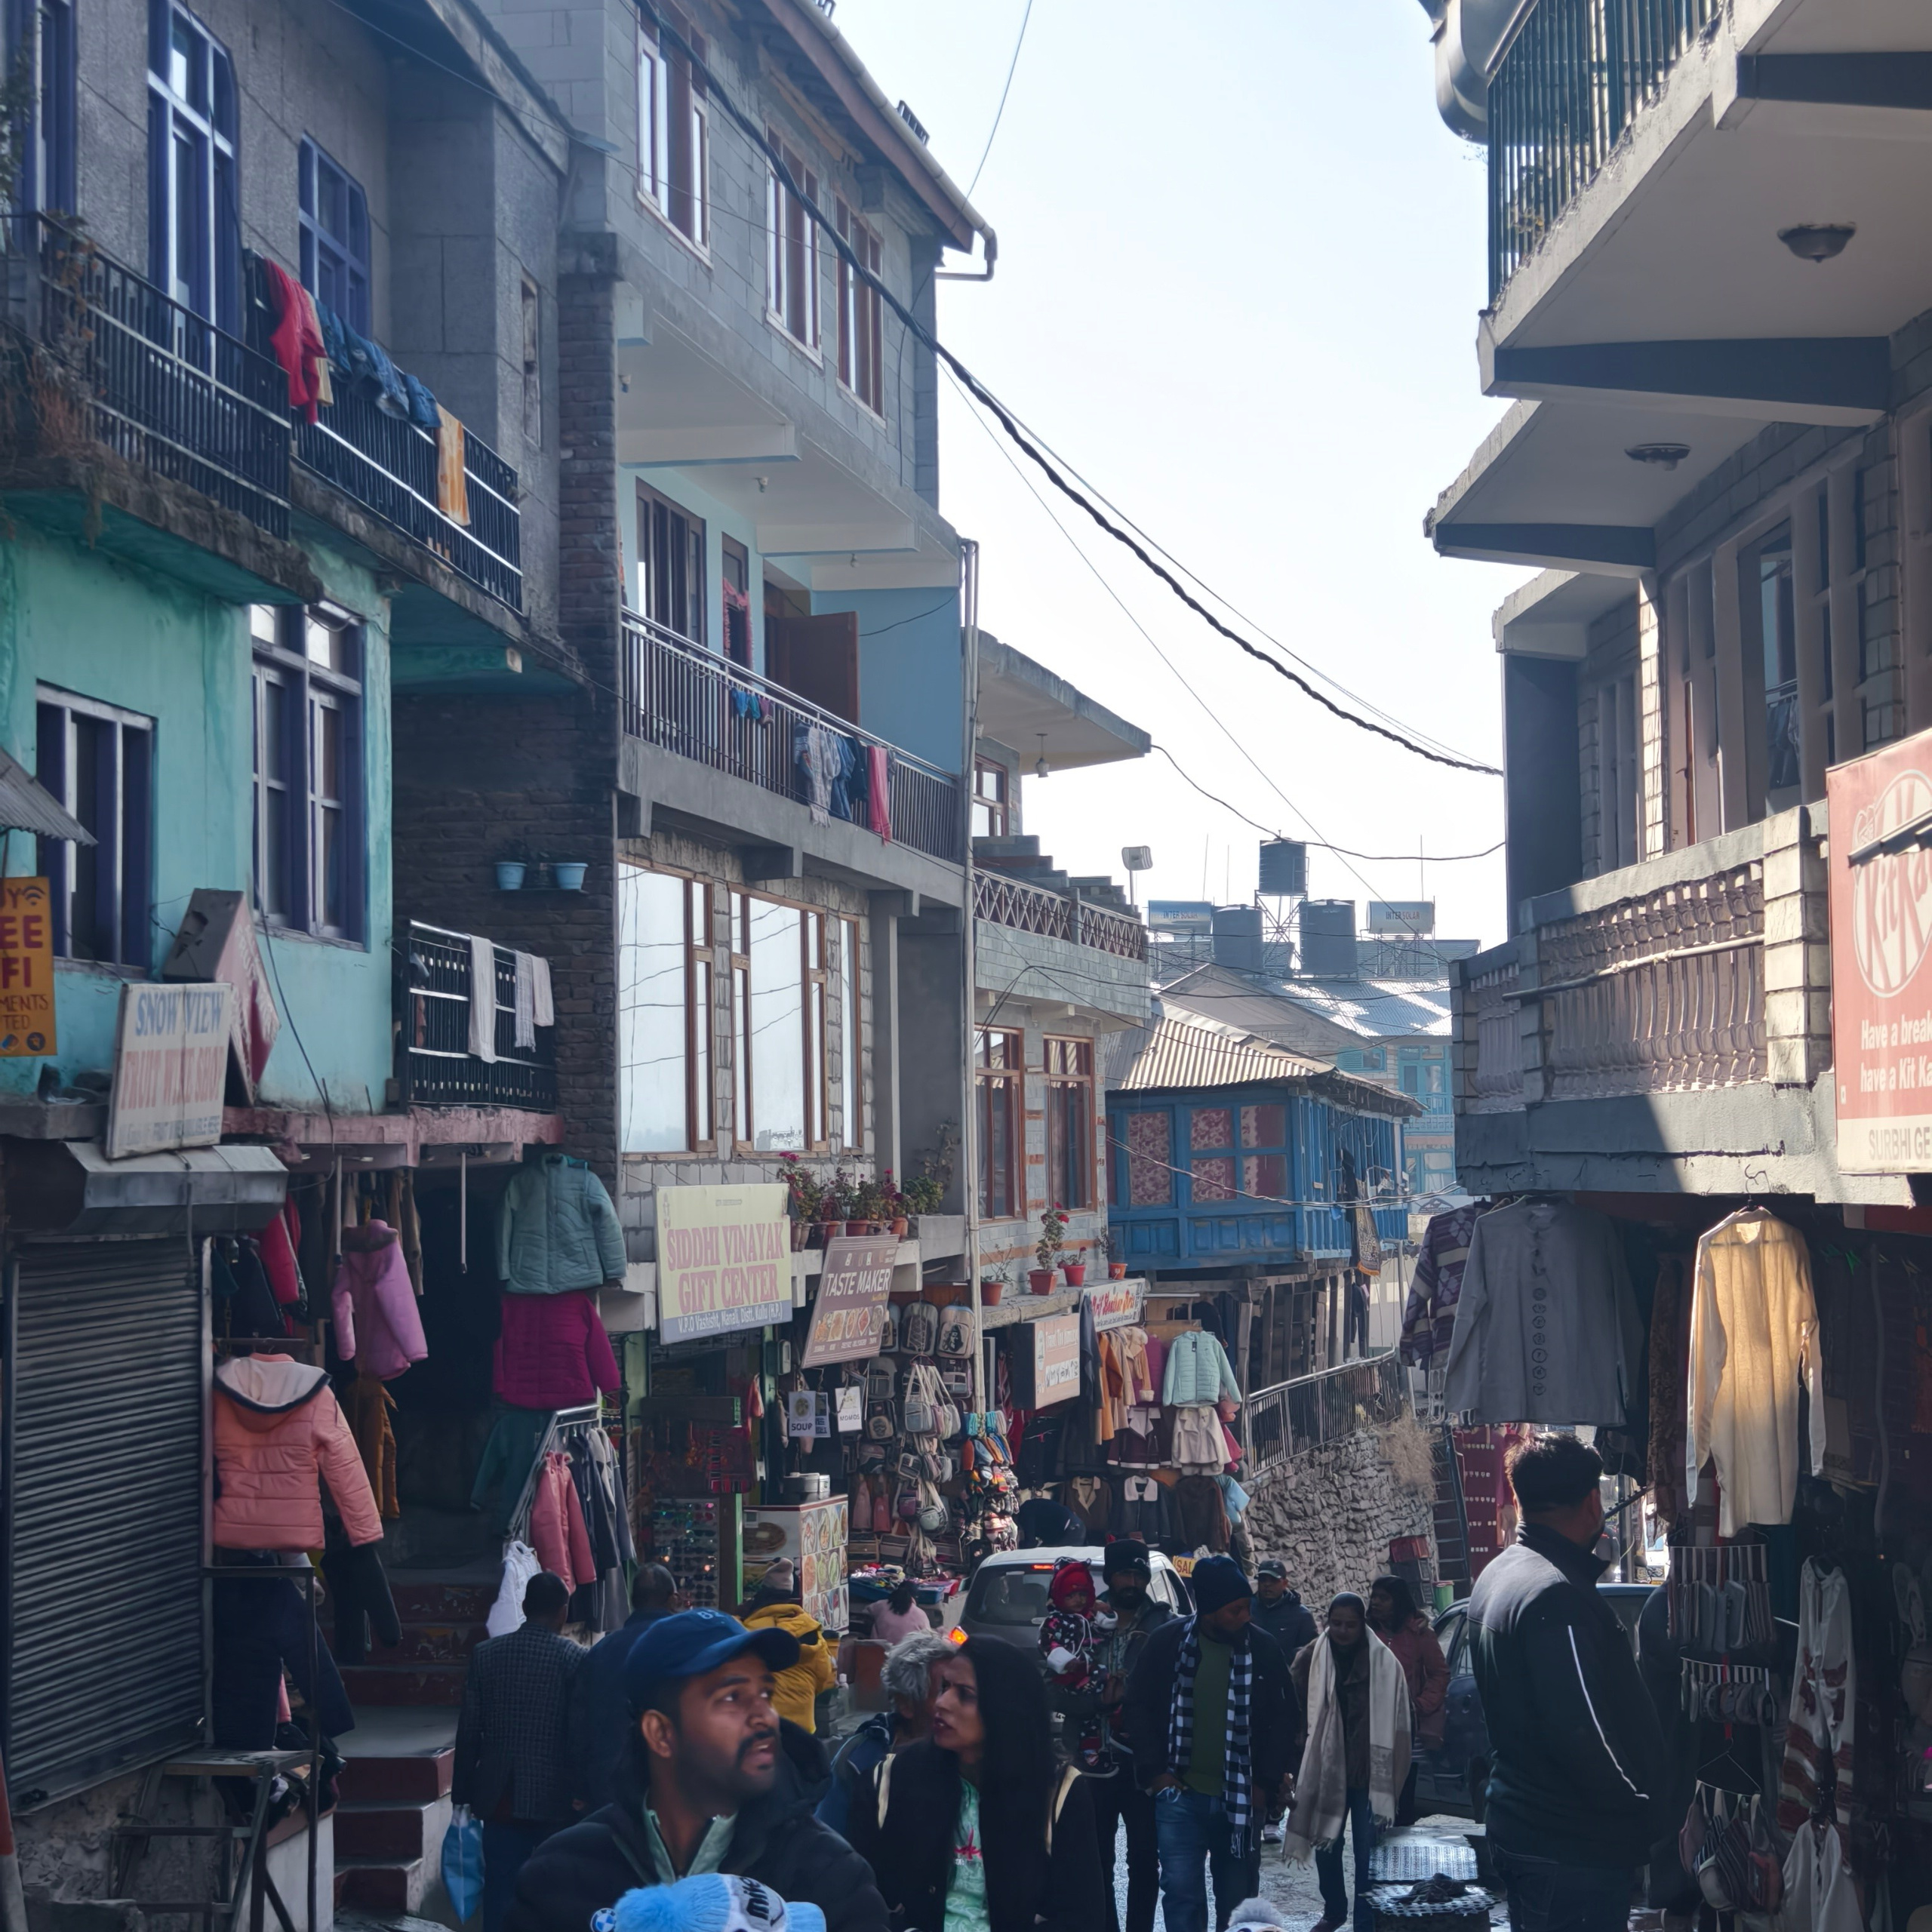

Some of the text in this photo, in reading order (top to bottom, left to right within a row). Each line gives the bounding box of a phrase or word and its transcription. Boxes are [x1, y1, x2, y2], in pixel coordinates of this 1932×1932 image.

[1163, 910, 1180, 919] INTER
[1386, 911, 1420, 920] INTER SOLAR
[0, 915, 43, 949] EE
[2, 956, 32, 989] FI
[0, 993, 49, 1012] MENTS
[135, 990, 225, 1036] SNOW VIEW
[2, 1014, 31, 1030] TED
[1861, 1019, 1888, 1051] Have
[1890, 1022, 1898, 1047] a
[1860, 1054, 1932, 1092] have a Kit Ka
[1869, 1126, 1932, 1161] SURBHI GE
[667, 1222, 785, 1272] SIDDHI VINAYAK
[678, 1263, 780, 1315] GIFT CENTER
[826, 1269, 891, 1297] TASTE MAKER
[791, 1423, 813, 1431] SOUP
[1177, 1560, 1192, 1574] SAL
